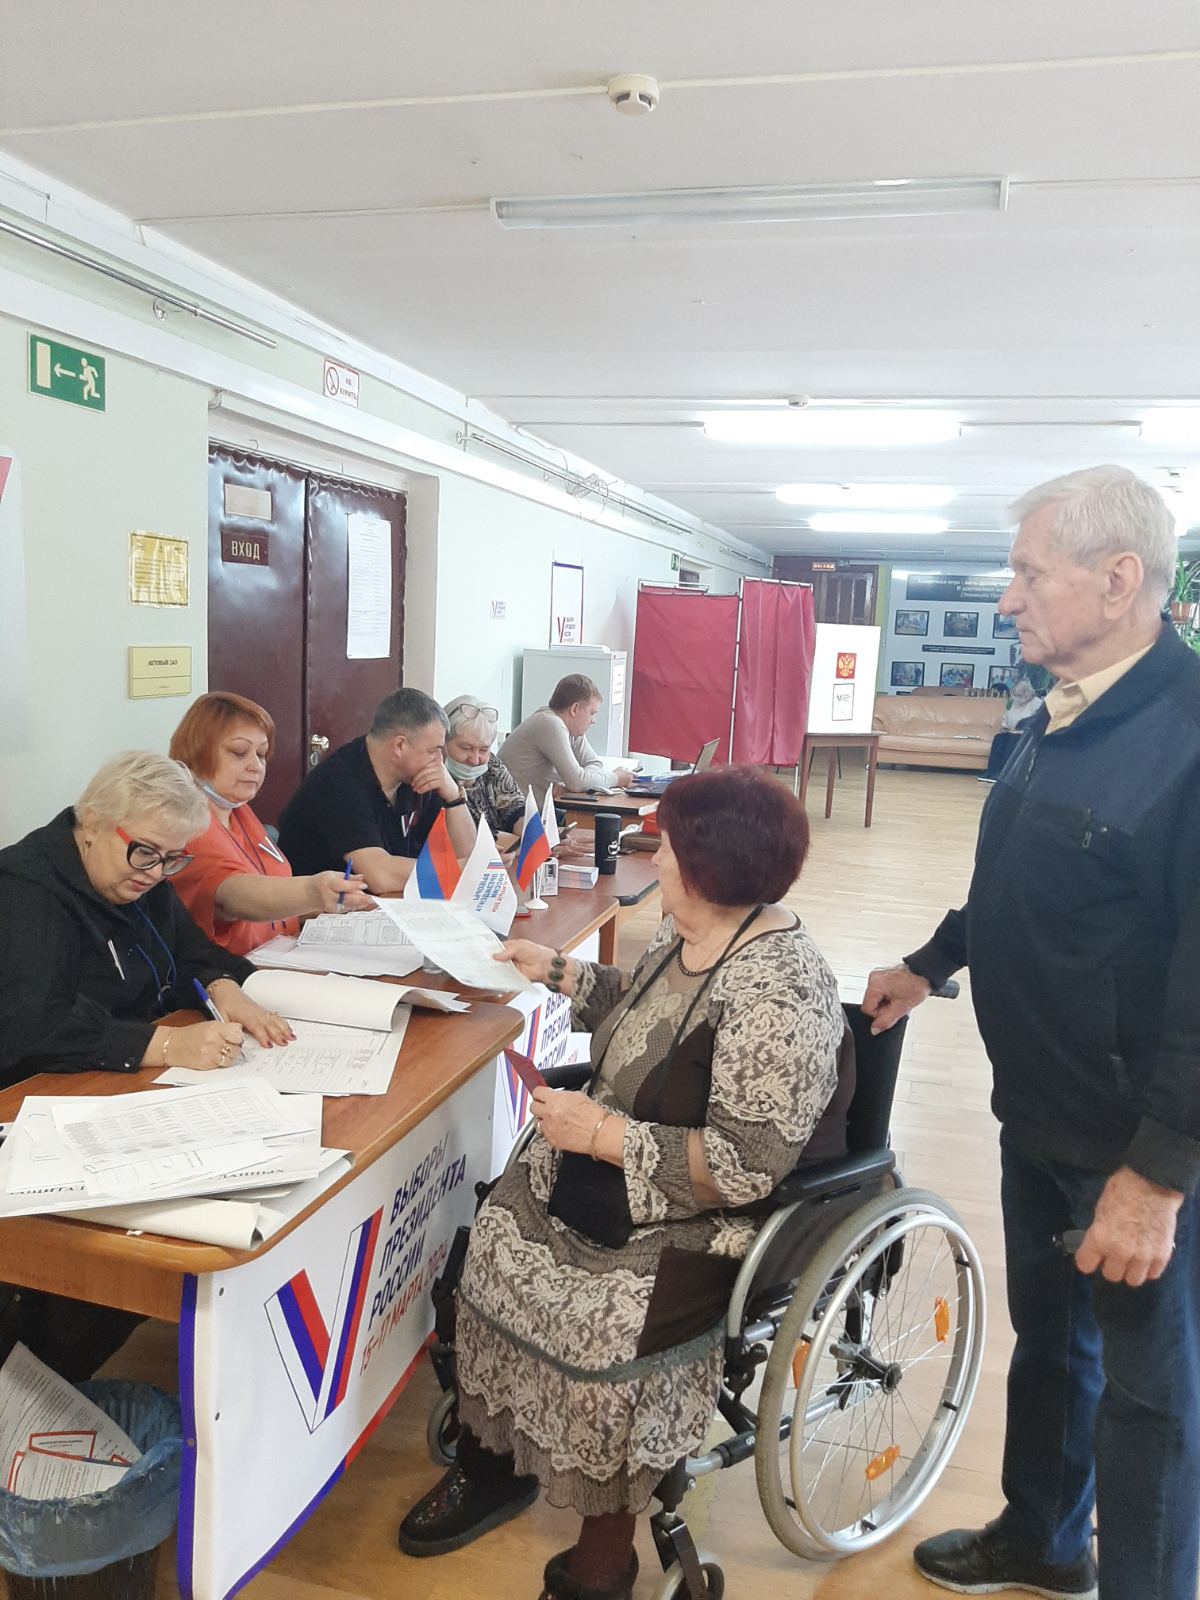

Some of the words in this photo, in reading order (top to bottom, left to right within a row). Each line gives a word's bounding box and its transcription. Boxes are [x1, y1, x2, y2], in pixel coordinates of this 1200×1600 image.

[231, 540, 260, 561] ВХОД
[379, 1153, 467, 1278] ПРЕЗИДЕНТА
[389, 1130, 450, 1226] ВЫБОРЫ
[368, 1229, 427, 1331] РОССИИ
[389, 1269, 425, 1335] МАРТА
